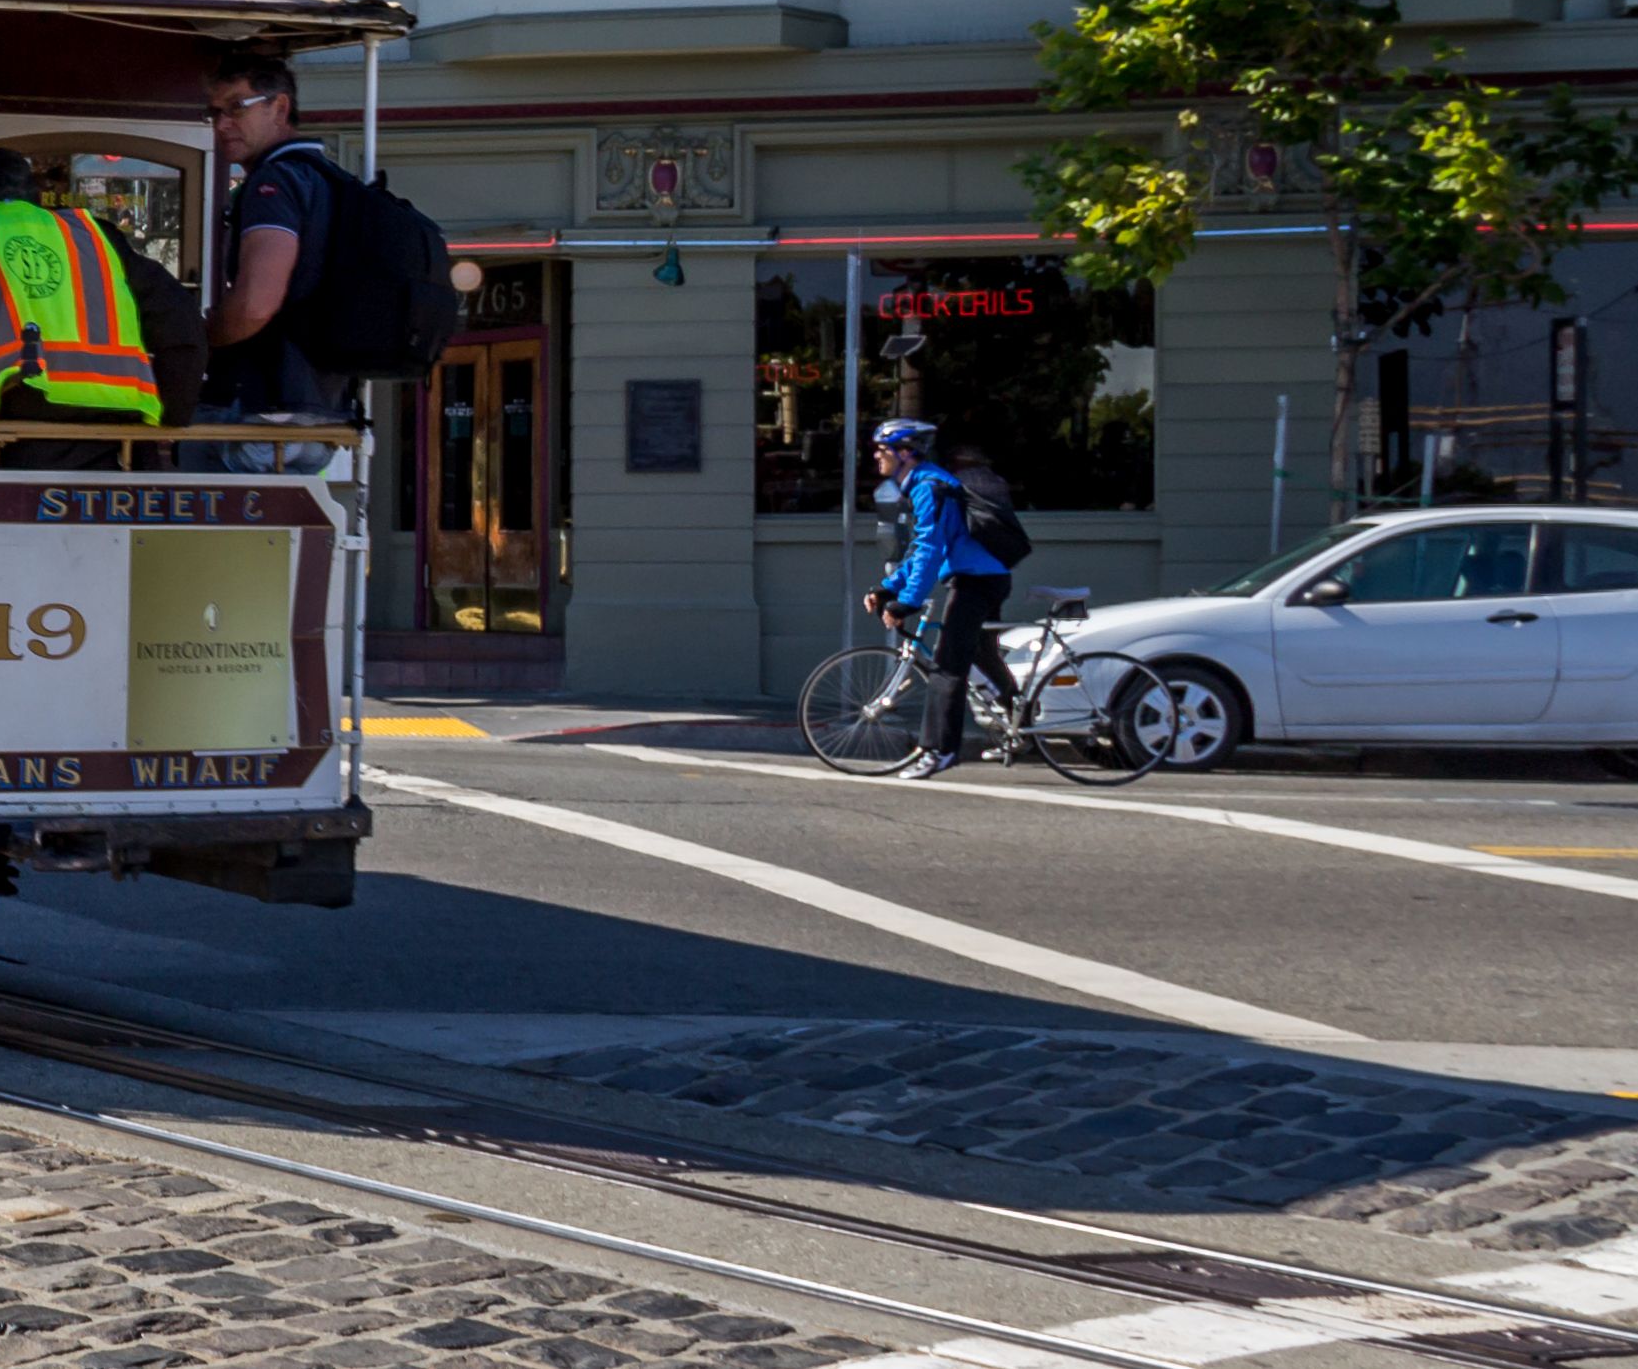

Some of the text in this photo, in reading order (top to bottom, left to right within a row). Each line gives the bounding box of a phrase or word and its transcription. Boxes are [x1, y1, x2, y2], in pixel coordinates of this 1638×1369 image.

[878, 288, 1034, 319] COCKTAILS
[37, 487, 225, 521] STREET
[131, 754, 282, 789] WHARF
